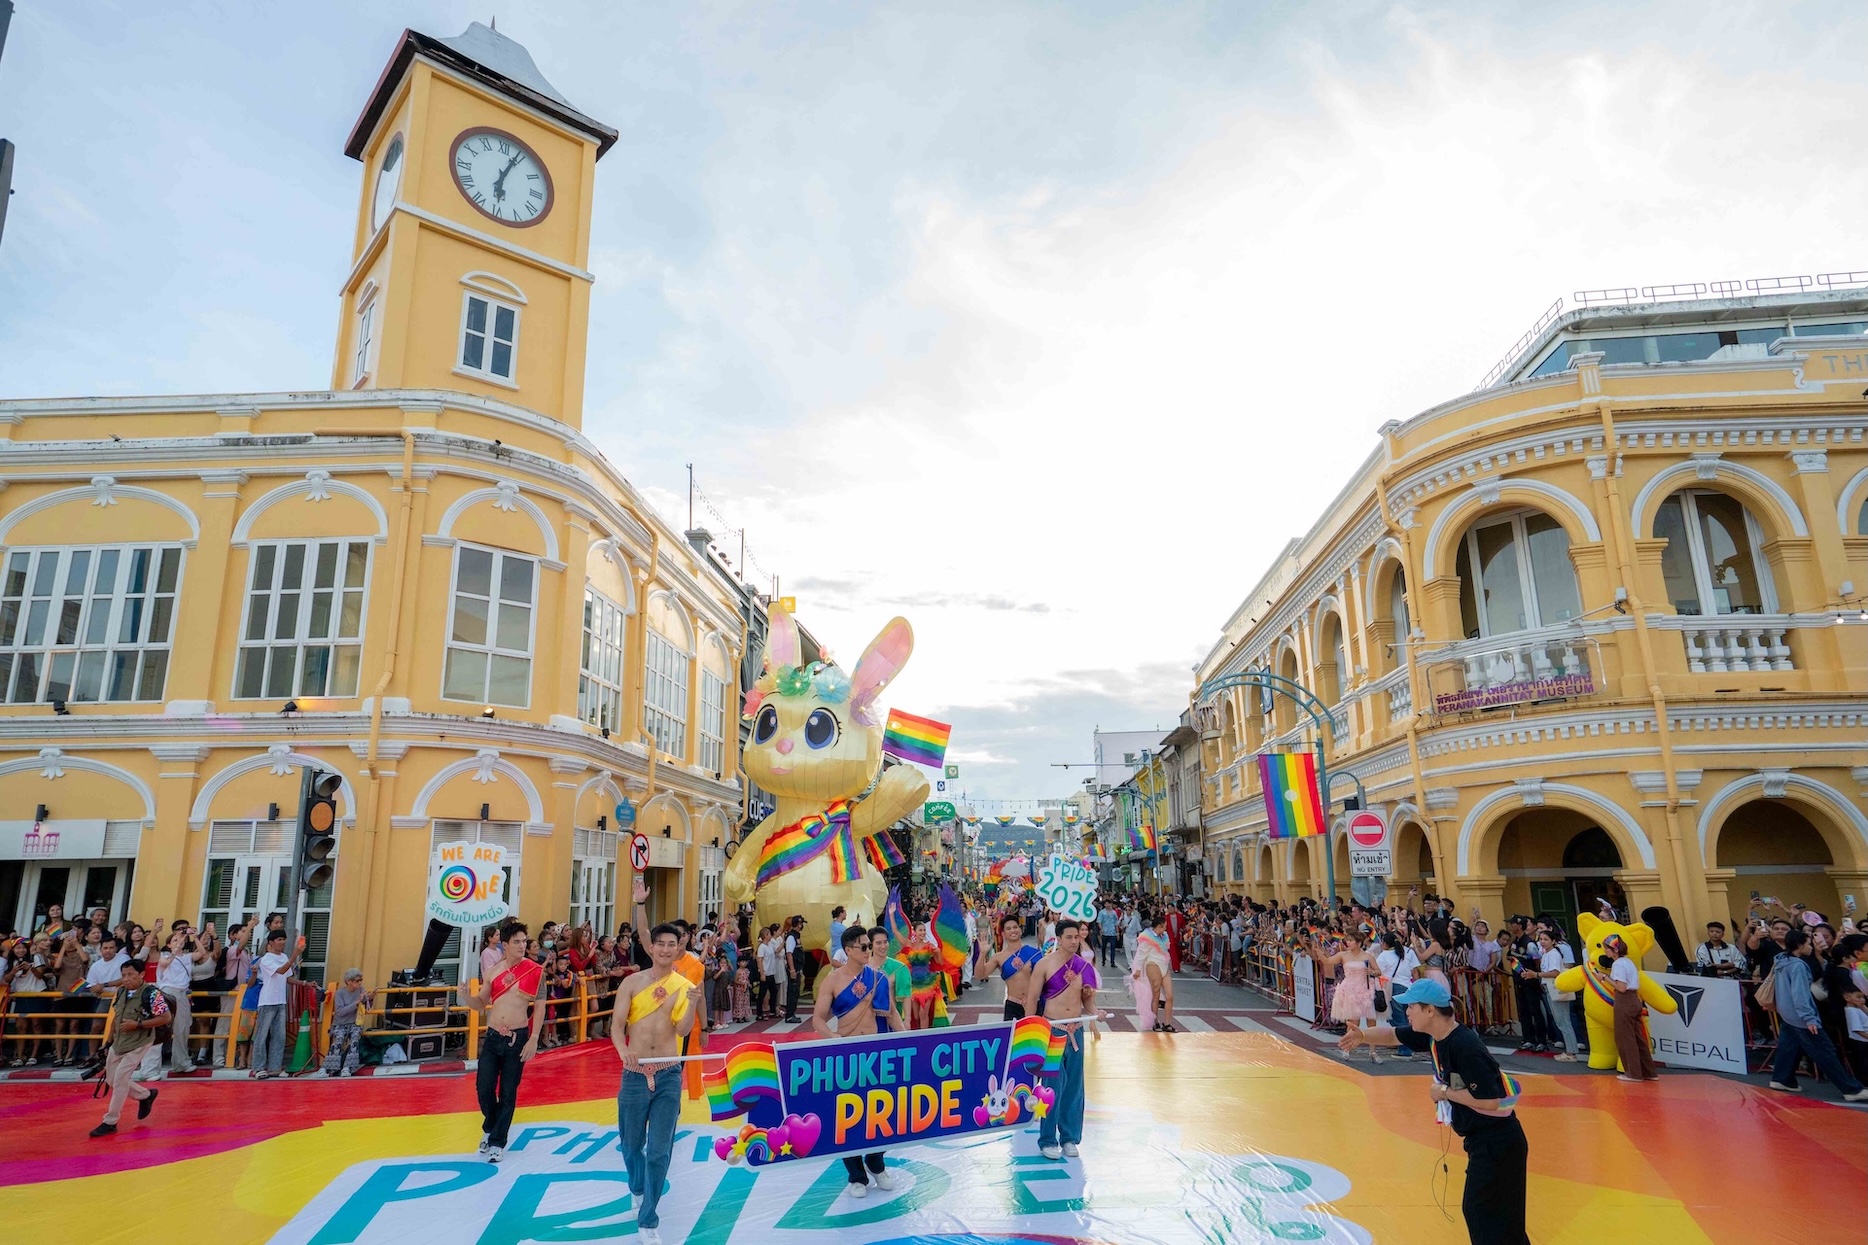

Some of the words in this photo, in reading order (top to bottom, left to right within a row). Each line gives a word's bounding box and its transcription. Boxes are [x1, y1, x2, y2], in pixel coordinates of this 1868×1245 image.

[1821, 354, 1868, 373] TH
[1537, 683, 1594, 698] MUSEUM
[442, 846, 464, 861] WE
[474, 847, 501, 864] ARE
[1053, 857, 1095, 885] PRIDE
[1040, 871, 1094, 918] 2026
[789, 1047, 918, 1097] PHUKET
[931, 1037, 1002, 1078] CITY
[834, 1078, 964, 1146] PRIDE
